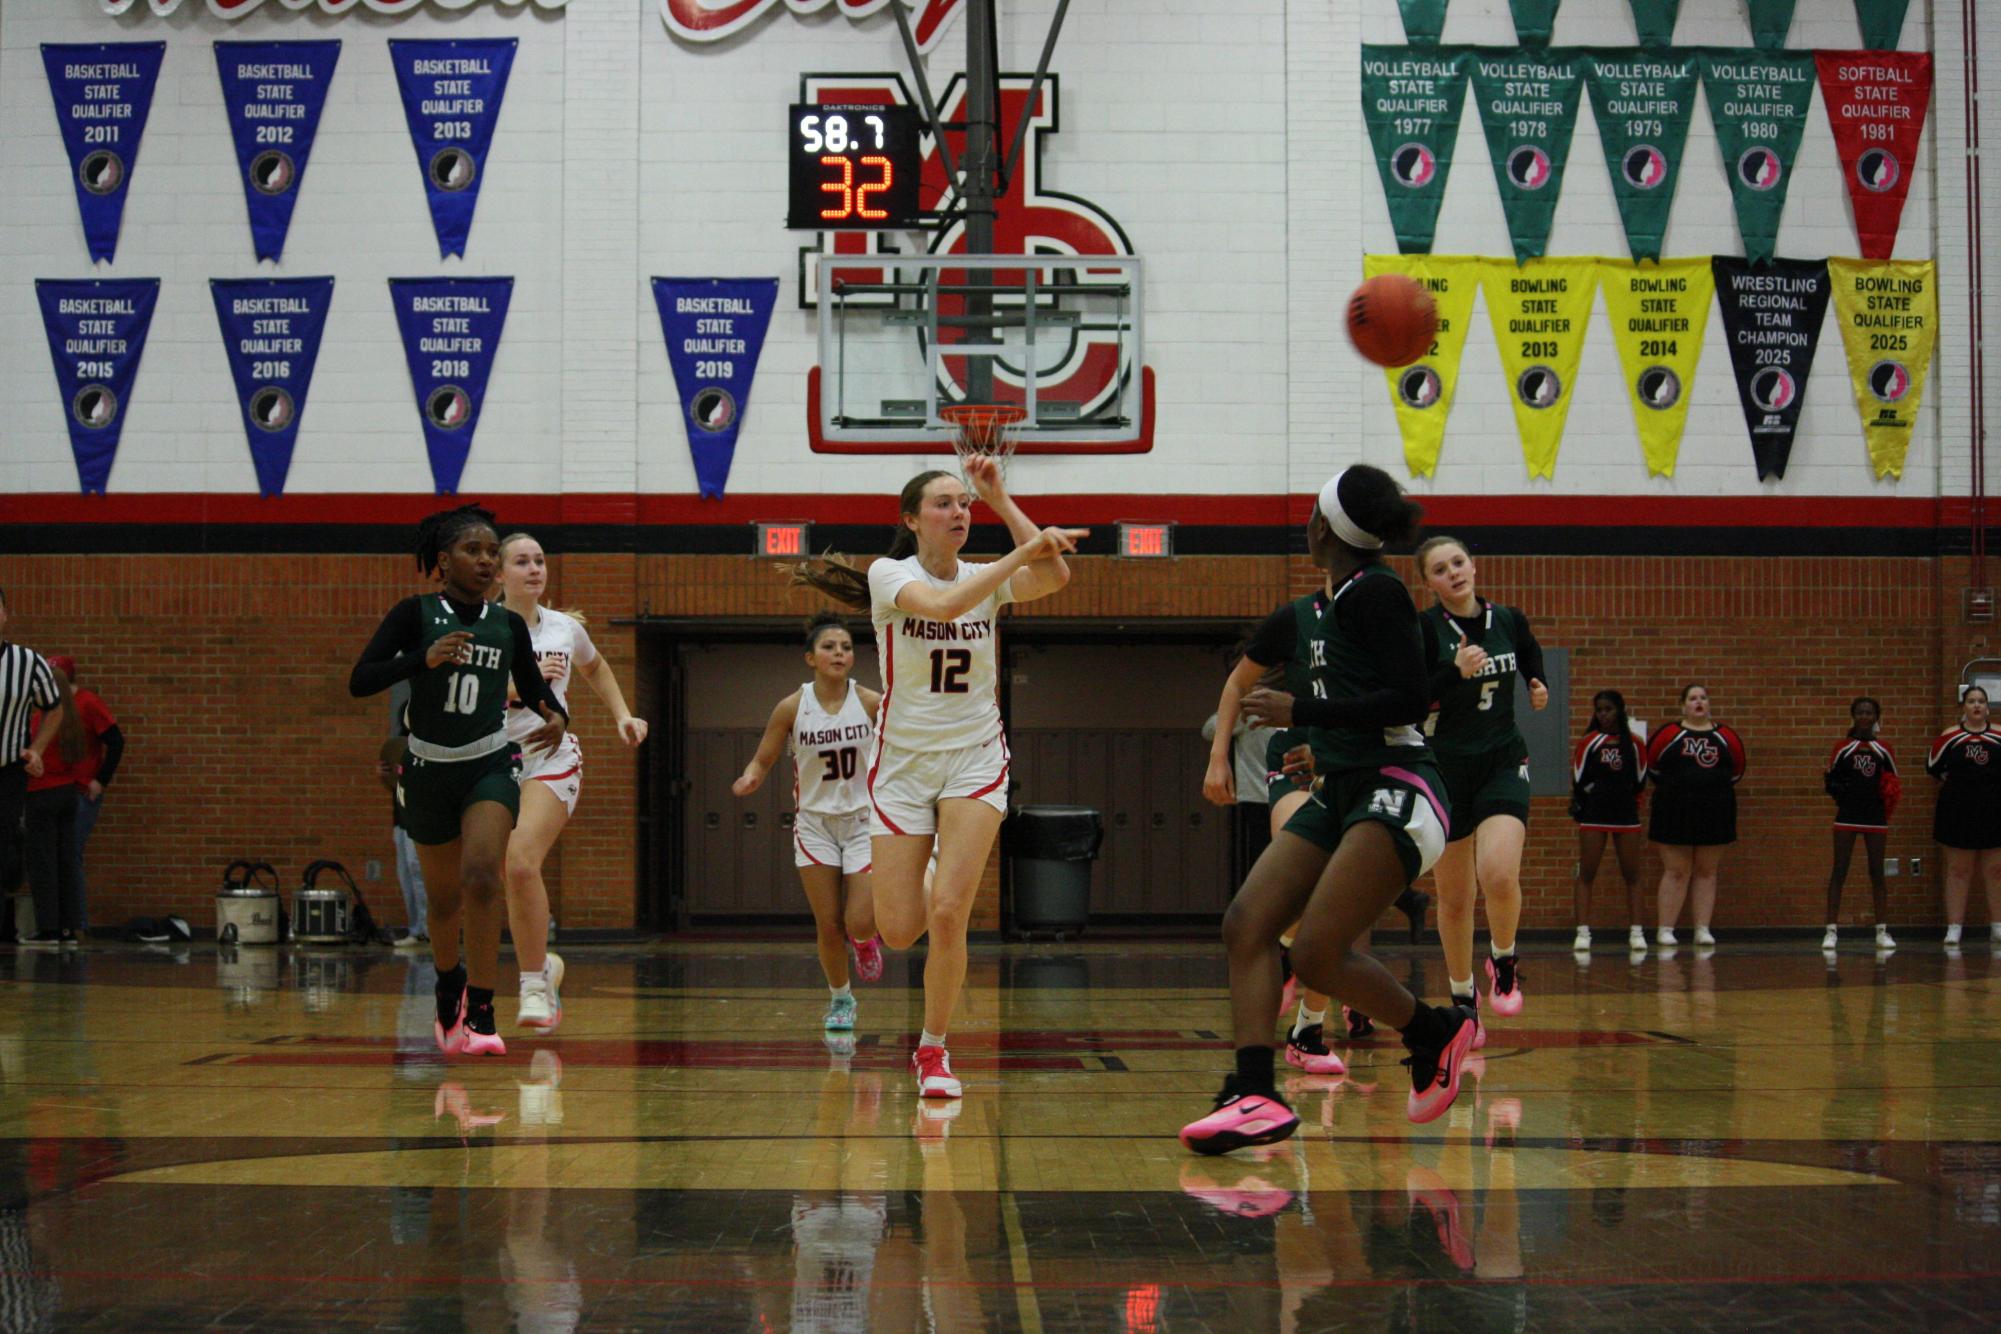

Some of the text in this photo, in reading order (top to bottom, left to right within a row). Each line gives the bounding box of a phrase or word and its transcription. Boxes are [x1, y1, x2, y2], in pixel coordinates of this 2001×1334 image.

[65, 64, 140, 79] BASKETBALL
[237, 64, 314, 79] BASKETBALL
[413, 59, 491, 75] BASKETBALL
[1364, 61, 1460, 76] VOLLEYBALL
[1479, 62, 1575, 79] VOLLEYBALL
[1594, 63, 1690, 79] VOLLEYBALL
[1711, 65, 1806, 81] VOLLEYBALL
[1838, 67, 1912, 83] SOFTBALL
[84, 85, 120, 99] STATE
[256, 85, 293, 99] STATE
[434, 80, 471, 95] STATE
[1389, 80, 1434, 95] STATE
[1505, 83, 1550, 97] STATE
[1620, 82, 1665, 97] STATE
[1737, 85, 1781, 99] STATE
[1854, 86, 1898, 101] STATE
[72, 104, 132, 118] QUALIFIER
[244, 104, 305, 118] QUALIFIER
[422, 99, 484, 114] QUALIFIER
[1377, 99, 1448, 112] QUALIFIER
[1492, 101, 1563, 115] QUALIFIER
[1608, 101, 1678, 114] QUALIFIER
[1724, 103, 1794, 117] QUALIFIER
[1841, 104, 1911, 119] QUALIFIER
[84, 126, 119, 142] 2011
[256, 126, 293, 142] 2012
[433, 121, 471, 139] 2013
[800, 115, 884, 153] 58.7
[1394, 118, 1431, 135] 1977
[1509, 121, 1547, 137] 1978
[1625, 120, 1662, 136] 1979
[1741, 122, 1778, 139] 1980
[1860, 124, 1895, 140] 1981
[821, 156, 892, 219] 32
[1511, 278, 1568, 293] BOWLING
[1630, 278, 1687, 293] BOWLING
[1731, 276, 1817, 293] WRESTLING
[1855, 277, 1922, 293] BOWLING
[59, 299, 135, 314] BASKETBALL
[233, 298, 310, 314] BASKETBALL
[413, 297, 491, 312] BASKETBALL
[676, 298, 754, 314] BASKETBALL
[1522, 299, 1557, 313] STATE
[1641, 299, 1677, 313] STATE
[1739, 295, 1807, 311] REGIONAL
[1867, 296, 1910, 311] STATE
[79, 320, 115, 334] STATE
[253, 319, 290, 334] STATE
[433, 318, 470, 333] STATE
[696, 319, 733, 334] STATE
[1510, 319, 1570, 333] QUALIFIER
[1628, 318, 1689, 332] QUALIFIER
[1755, 312, 1792, 327] TEAM
[1854, 314, 1924, 329] QUALIFIER
[65, 339, 127, 353] QUALIFIER
[241, 339, 302, 353] QUALIFIER
[420, 338, 482, 352] QUALIFIER
[684, 339, 745, 353] QUALIFIER
[1738, 331, 1808, 346] CHAMPION
[1870, 334, 1907, 351] 2025
[1522, 341, 1558, 358] 2013
[1640, 340, 1677, 356] 2014
[1755, 349, 1791, 365] 2025
[77, 361, 113, 378] 2015
[252, 361, 290, 378] 2016
[432, 360, 469, 377] 2018
[695, 361, 733, 378] 2019
[766, 527, 801, 555] EXIT
[1128, 527, 1163, 555] EXIT
[902, 617, 991, 641] MASON CITY
[930, 648, 971, 693] 12
[443, 671, 480, 715] 10
[1477, 681, 1500, 711] 5
[800, 729, 842, 746] MASON
[818, 747, 858, 781] 30
